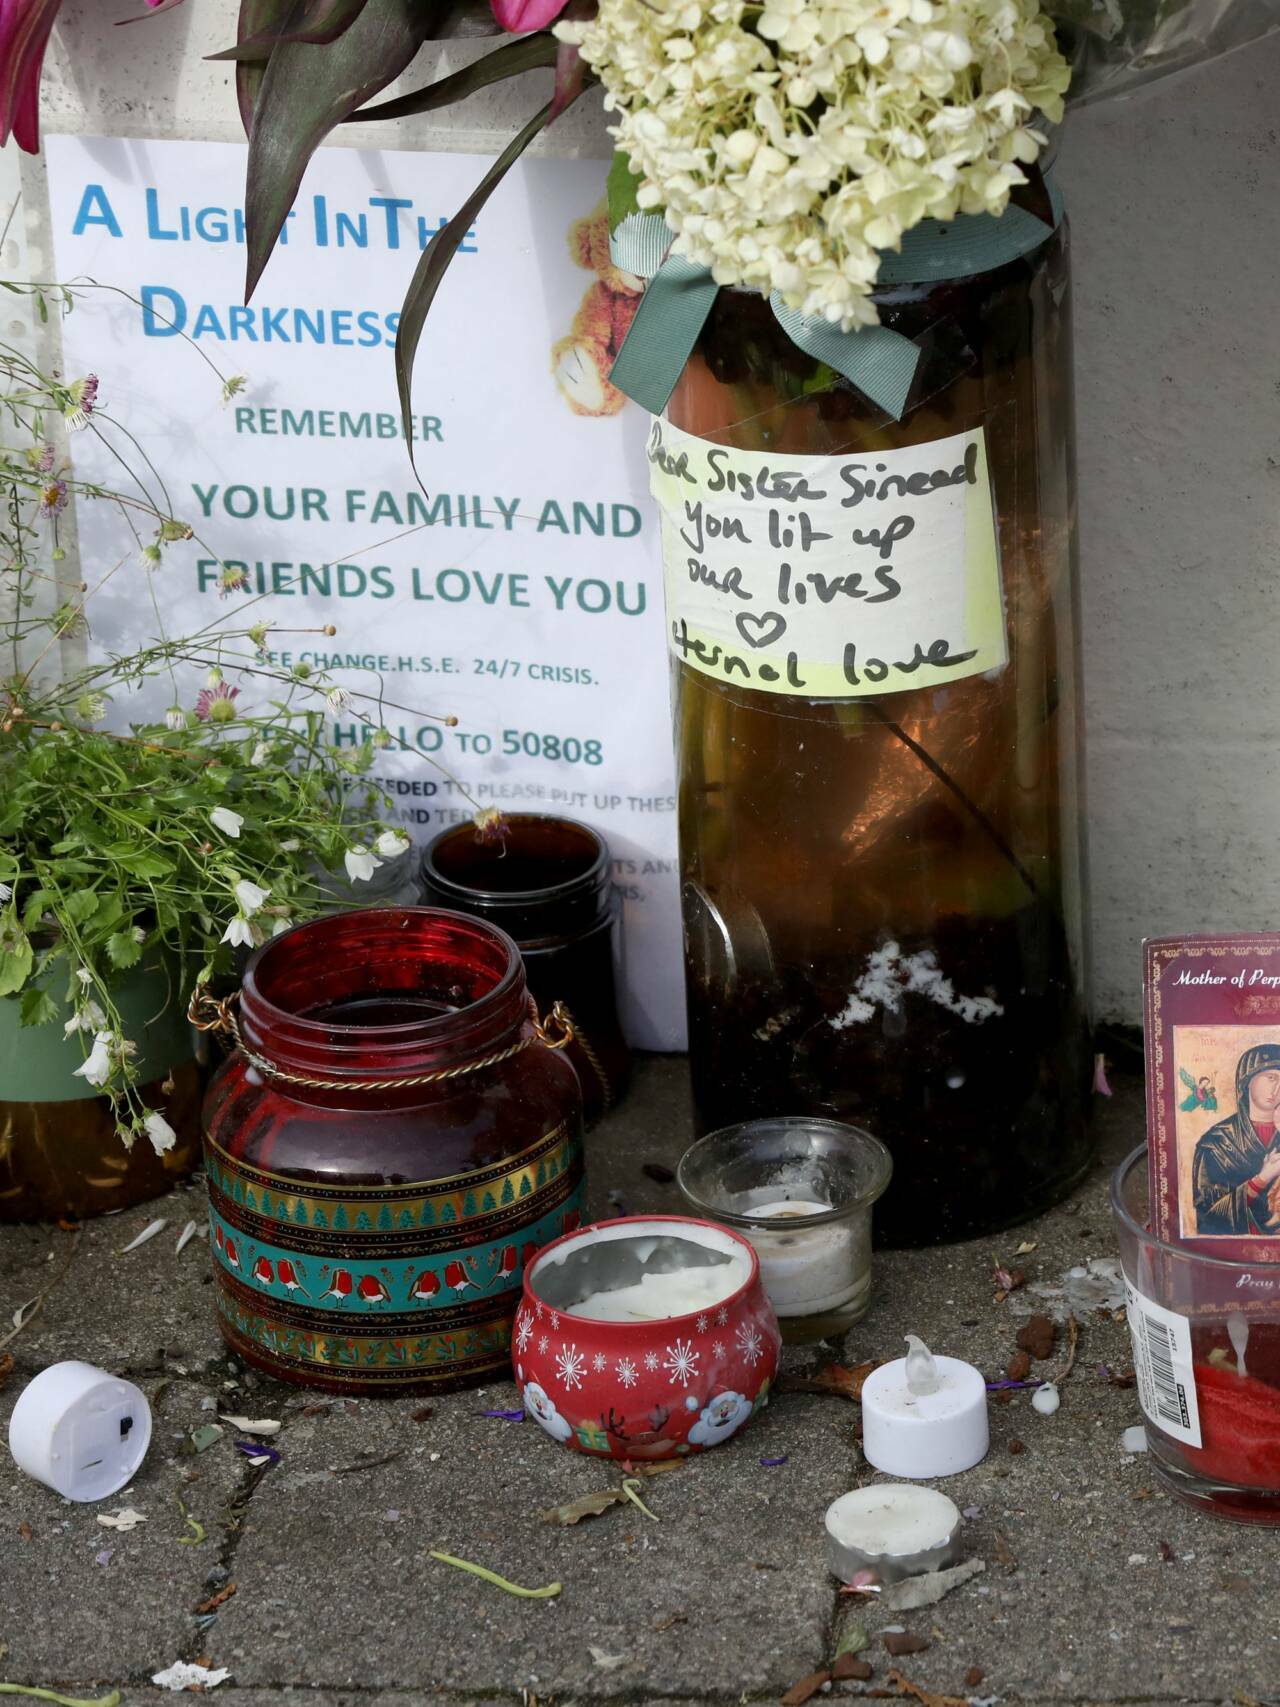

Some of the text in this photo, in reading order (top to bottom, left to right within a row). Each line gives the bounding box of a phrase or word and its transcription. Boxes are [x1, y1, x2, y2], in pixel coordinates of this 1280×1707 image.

[72, 184, 124, 238] A
[140, 285, 402, 348] DARKNESS
[234, 406, 445, 443] REMEMBER
[840, 442, 978, 508] Sinead
[191, 483, 643, 538] YOUR FAMILY AND
[769, 508, 833, 552] lit
[852, 515, 915, 559] up
[196, 559, 648, 616] FRIENDS LOVE YOU
[778, 563, 902, 604] lives
[473, 659, 522, 679] 24/7
[528, 664, 600, 686] CRISIS.
[844, 639, 979, 685] love
[454, 732, 493, 755] TO
[503, 729, 604, 766] 50808
[443, 781, 472, 797] TO
[477, 783, 546, 799] PLEASE
[552, 788, 587, 807] PUT
[593, 795, 621, 811] UP
[626, 796, 677, 813] THES
[1172, 968, 1227, 987] Mother
[1231, 969, 1246, 988] of
[1235, 1273, 1274, 1290] Pray
